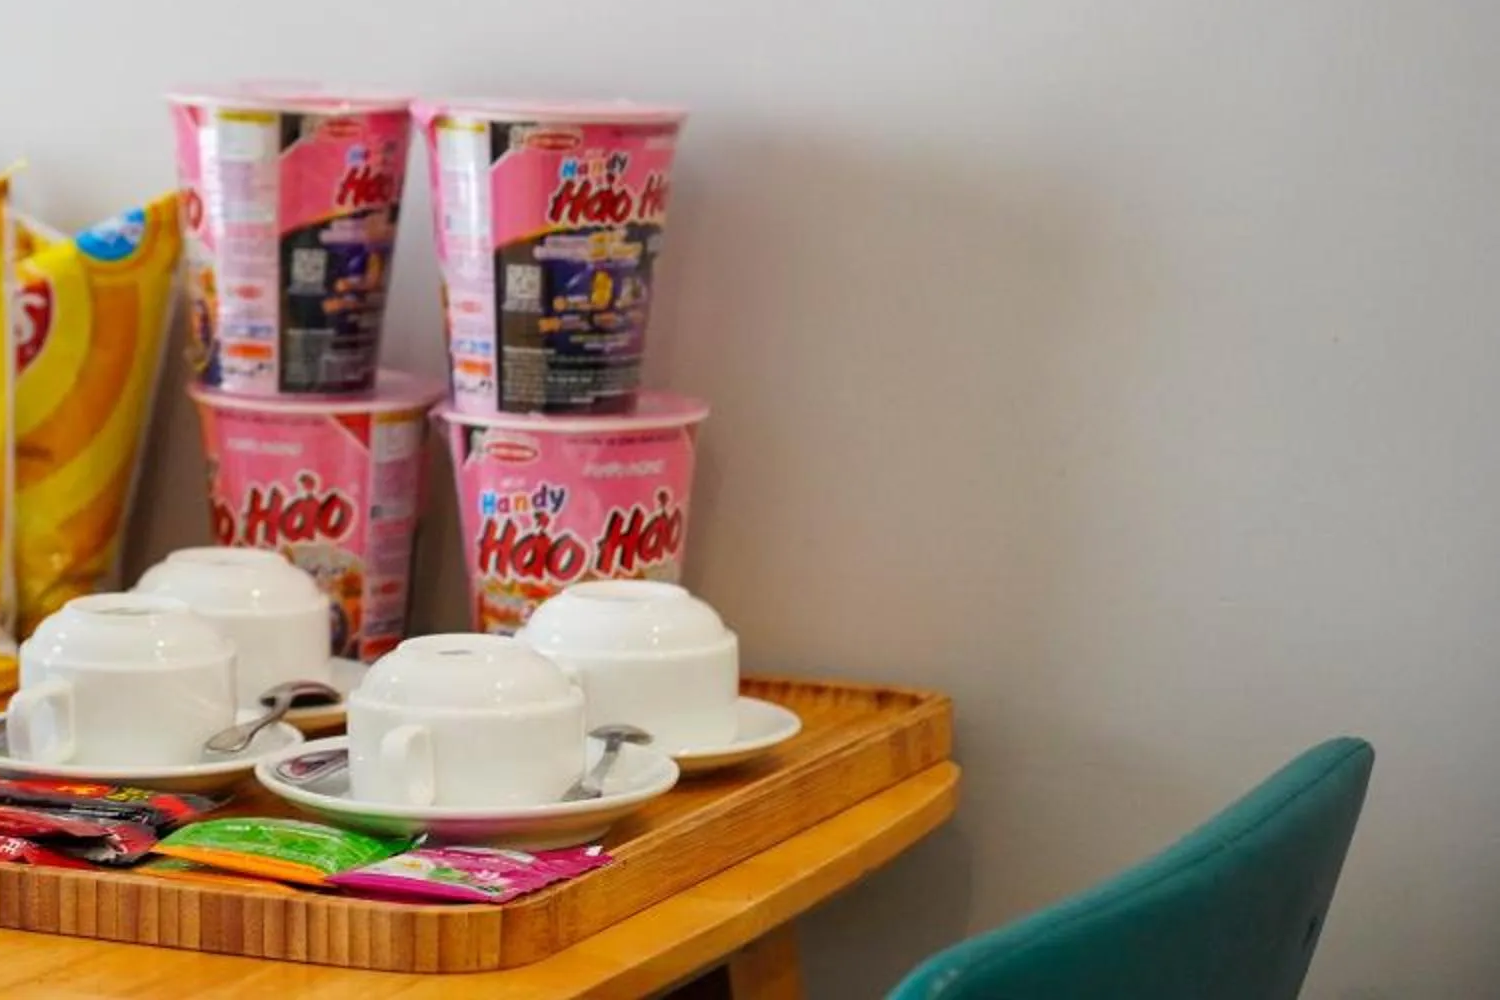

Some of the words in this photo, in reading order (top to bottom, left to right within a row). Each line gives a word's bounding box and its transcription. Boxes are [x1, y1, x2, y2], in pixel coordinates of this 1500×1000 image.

[243, 473, 355, 546] Hảo
[479, 484, 566, 514] Handy
[479, 511, 586, 581] Hảo
